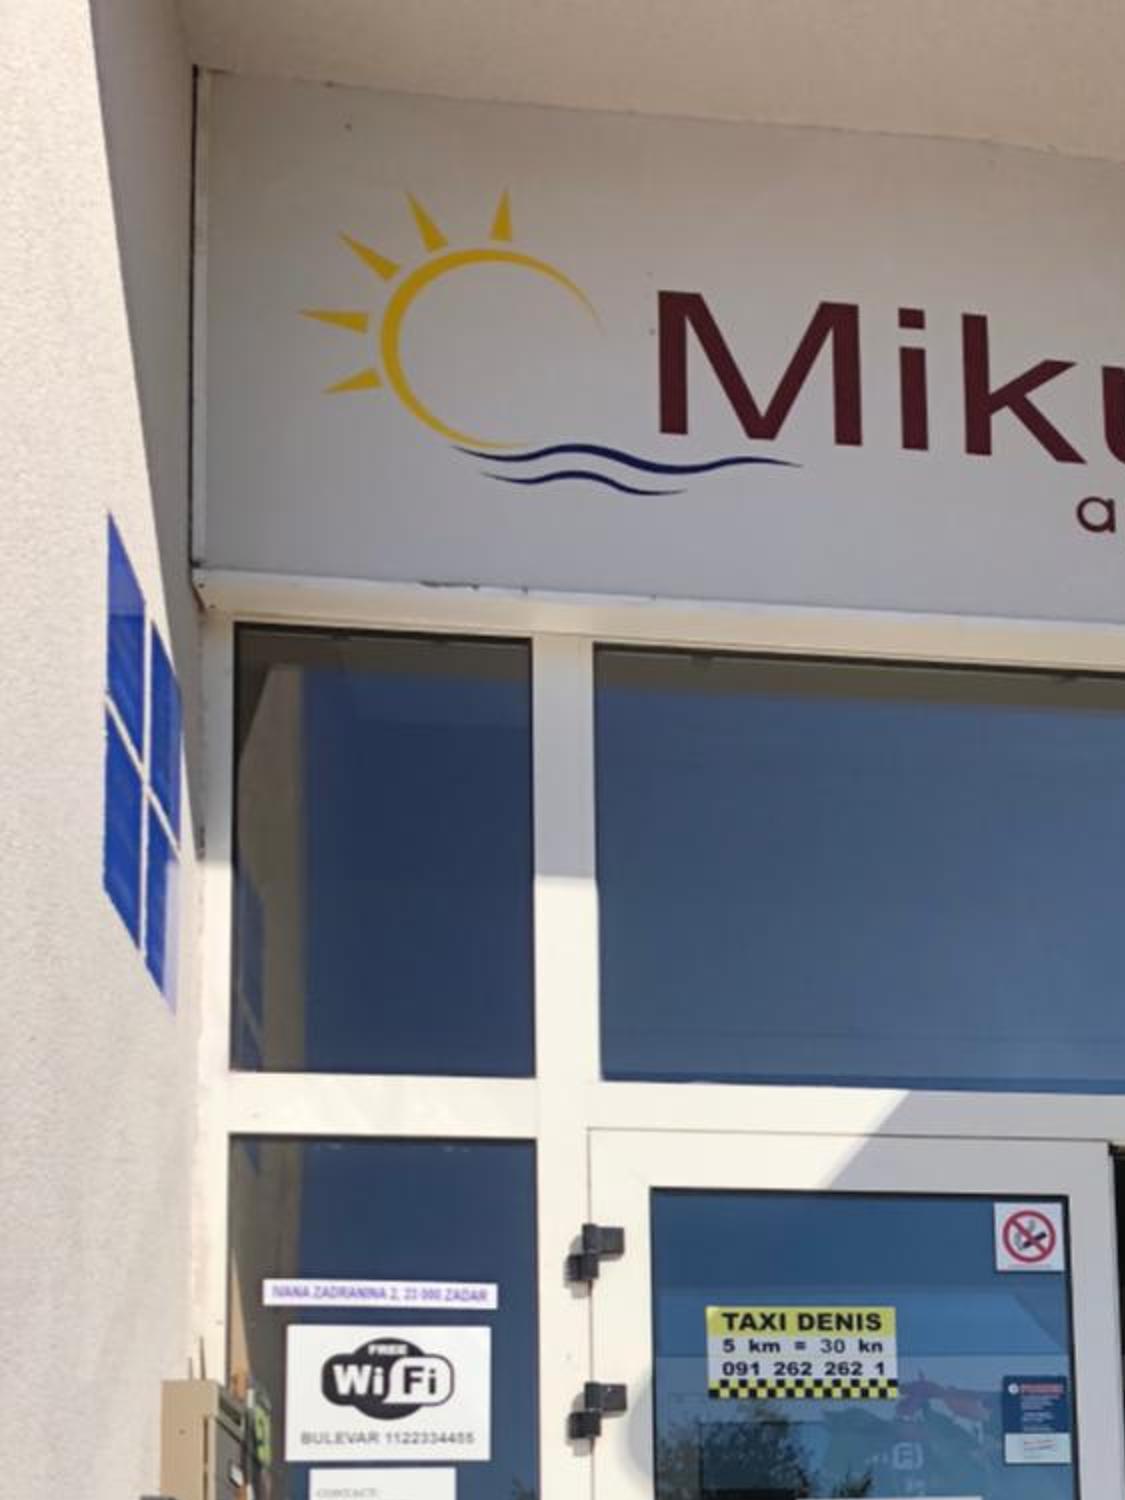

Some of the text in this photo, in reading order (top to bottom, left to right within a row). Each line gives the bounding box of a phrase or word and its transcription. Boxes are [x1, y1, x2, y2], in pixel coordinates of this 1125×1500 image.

[721, 1313, 882, 1331] TAXI DENIS
[723, 1338, 735, 1353] 5
[749, 1338, 781, 1353] km
[820, 1338, 846, 1353] 30
[859, 1338, 883, 1353] kn
[722, 1361, 885, 1377] 091 262 262 1
[300, 1431, 380, 1445] BULEVAR
